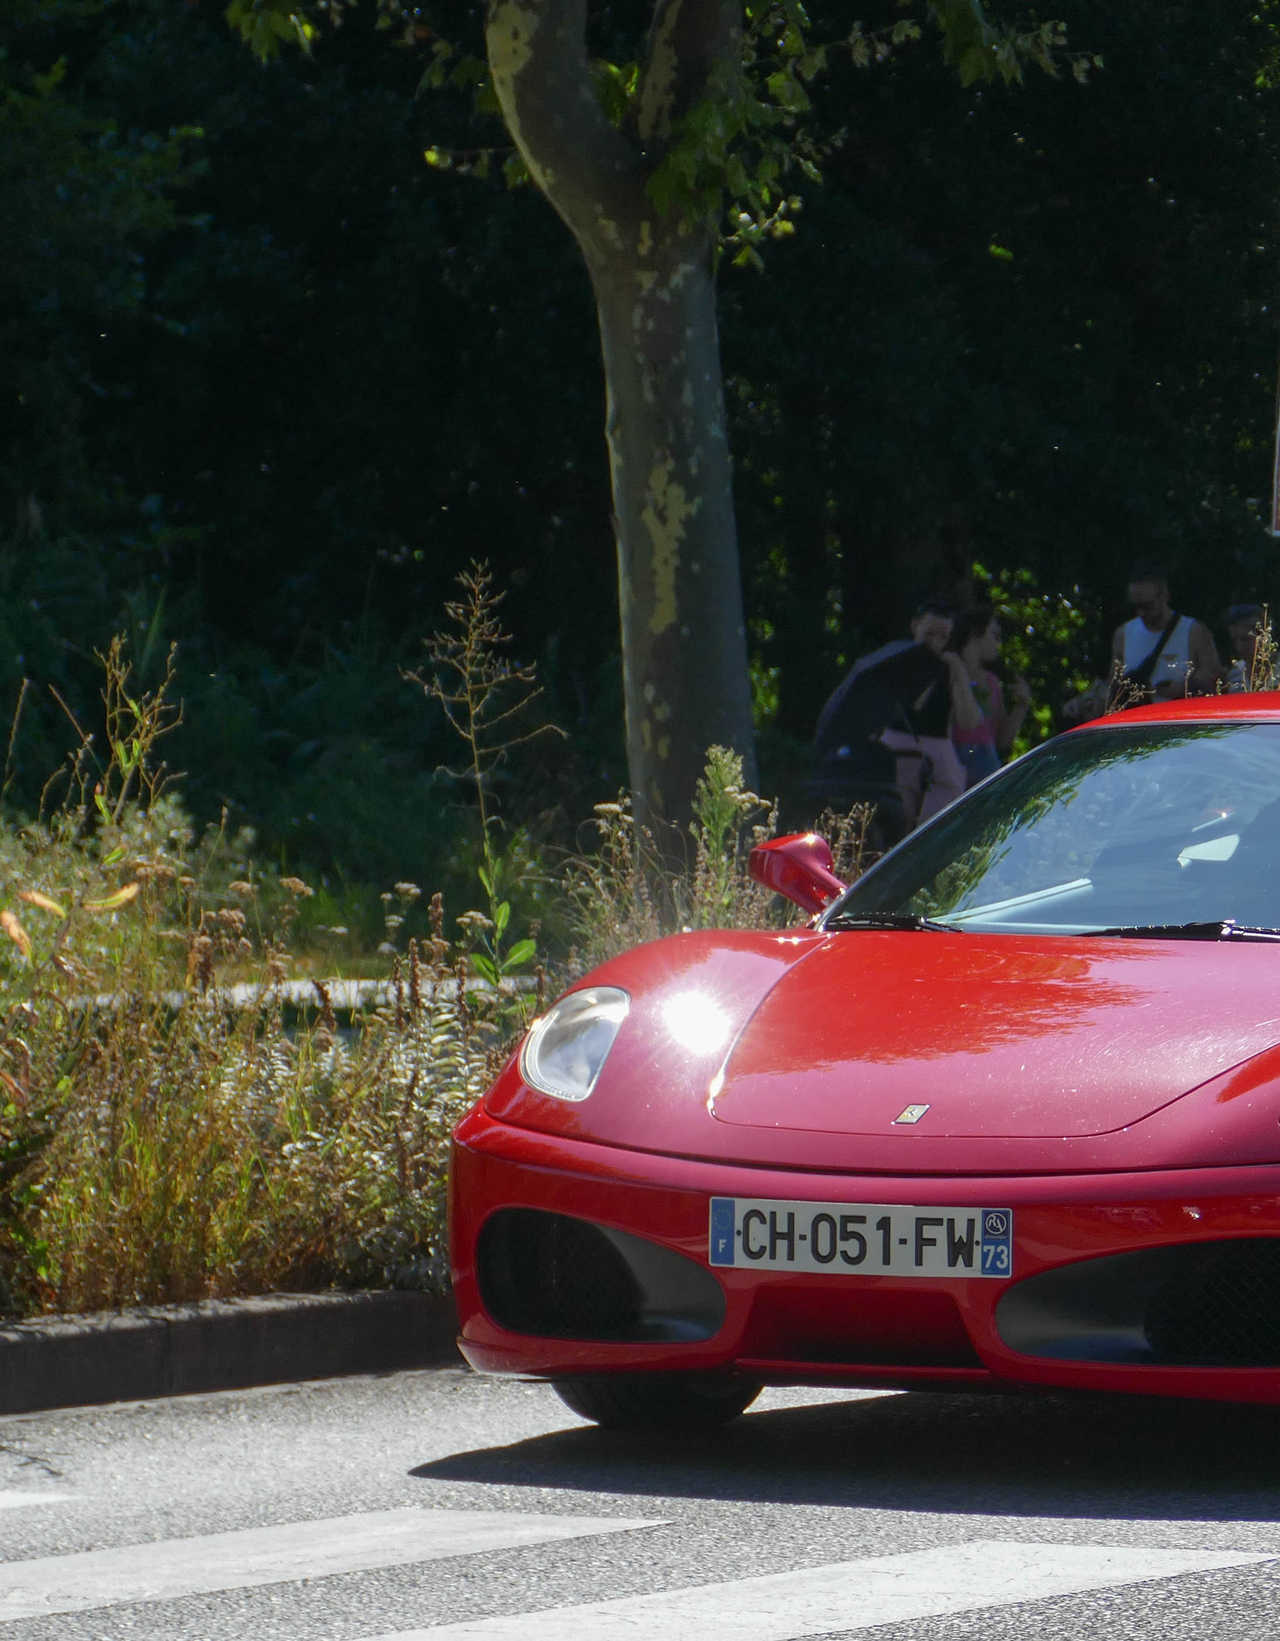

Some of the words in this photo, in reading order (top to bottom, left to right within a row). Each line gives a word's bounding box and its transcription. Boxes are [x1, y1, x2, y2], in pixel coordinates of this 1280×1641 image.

[718, 1238, 727, 1253] F
[742, 1208, 975, 1268] CH-051-FW
[983, 1245, 1008, 1269] 73
